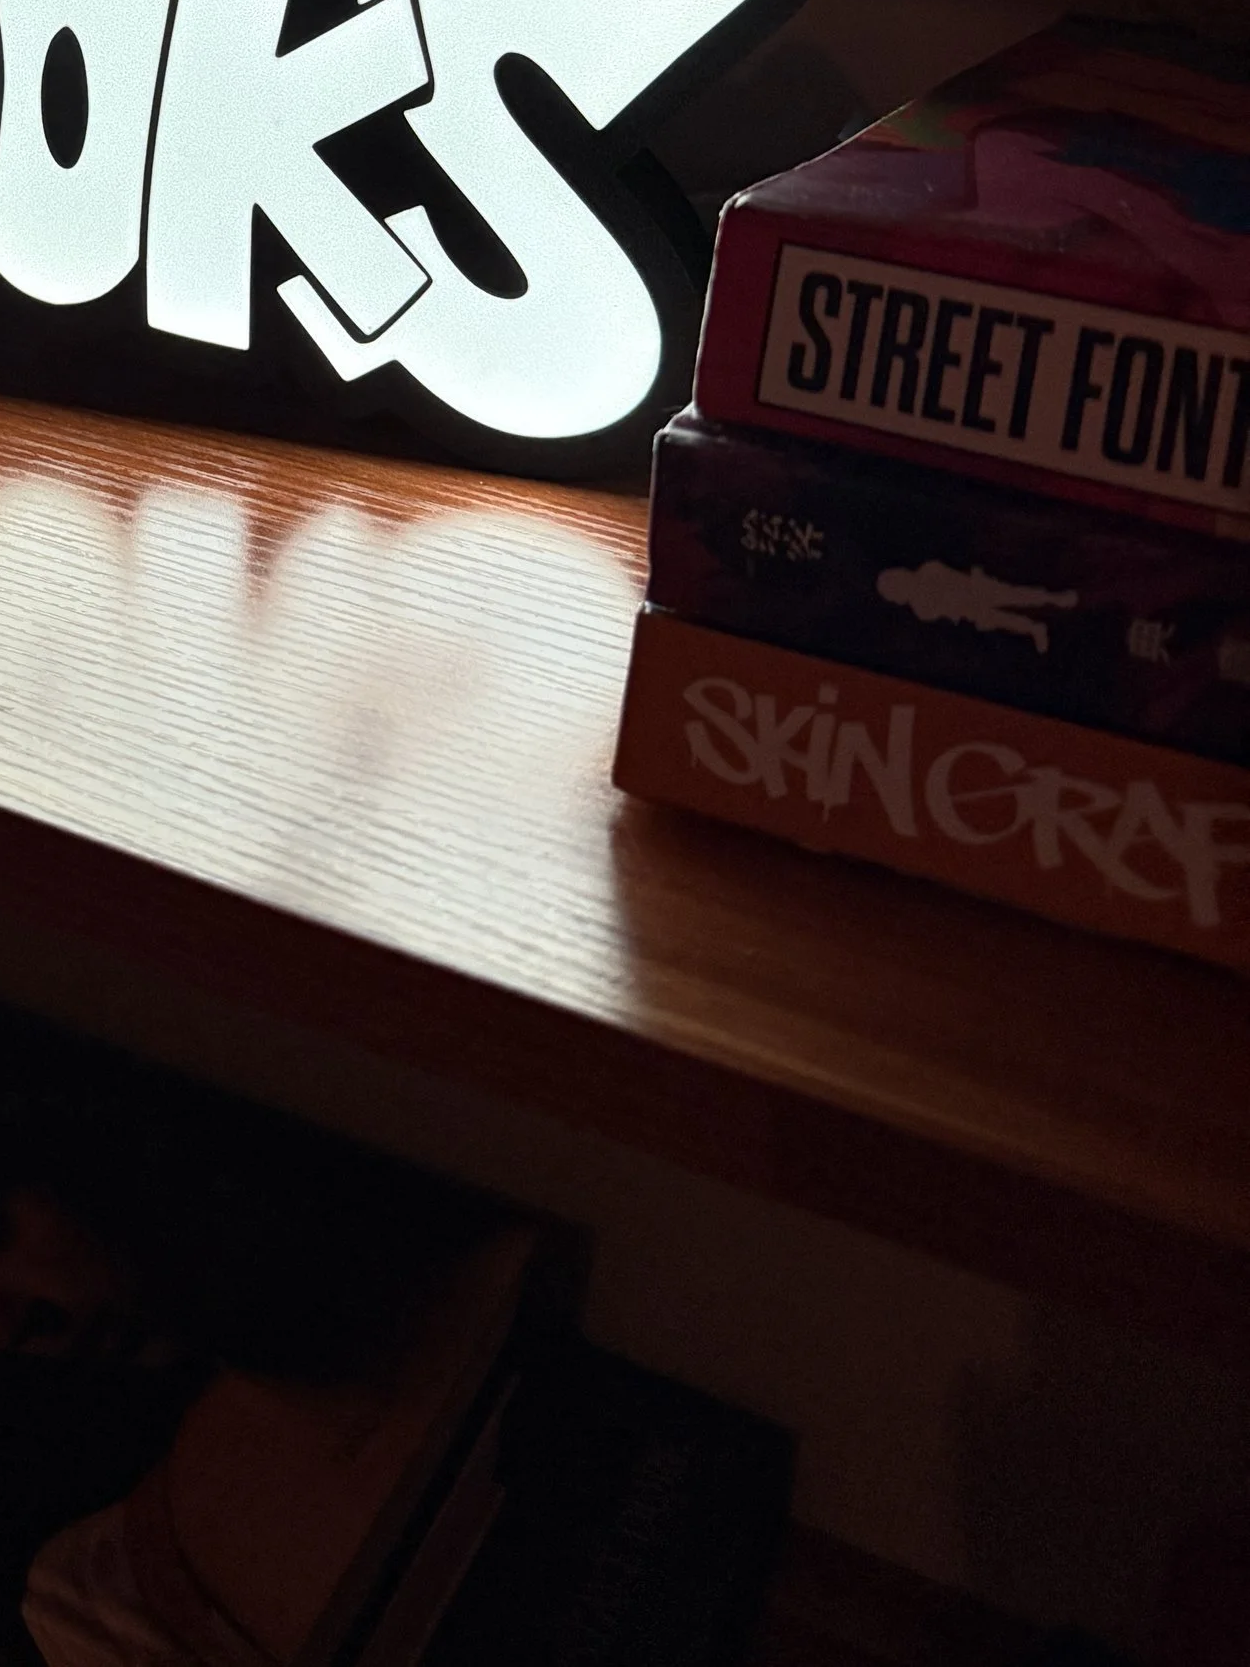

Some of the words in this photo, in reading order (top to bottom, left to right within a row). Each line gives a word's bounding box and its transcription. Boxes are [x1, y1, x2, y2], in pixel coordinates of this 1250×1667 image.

[788, 272, 1055, 439] STREET
[1061, 326, 1250, 488] FONT
[924, 740, 1250, 928] GRAF
